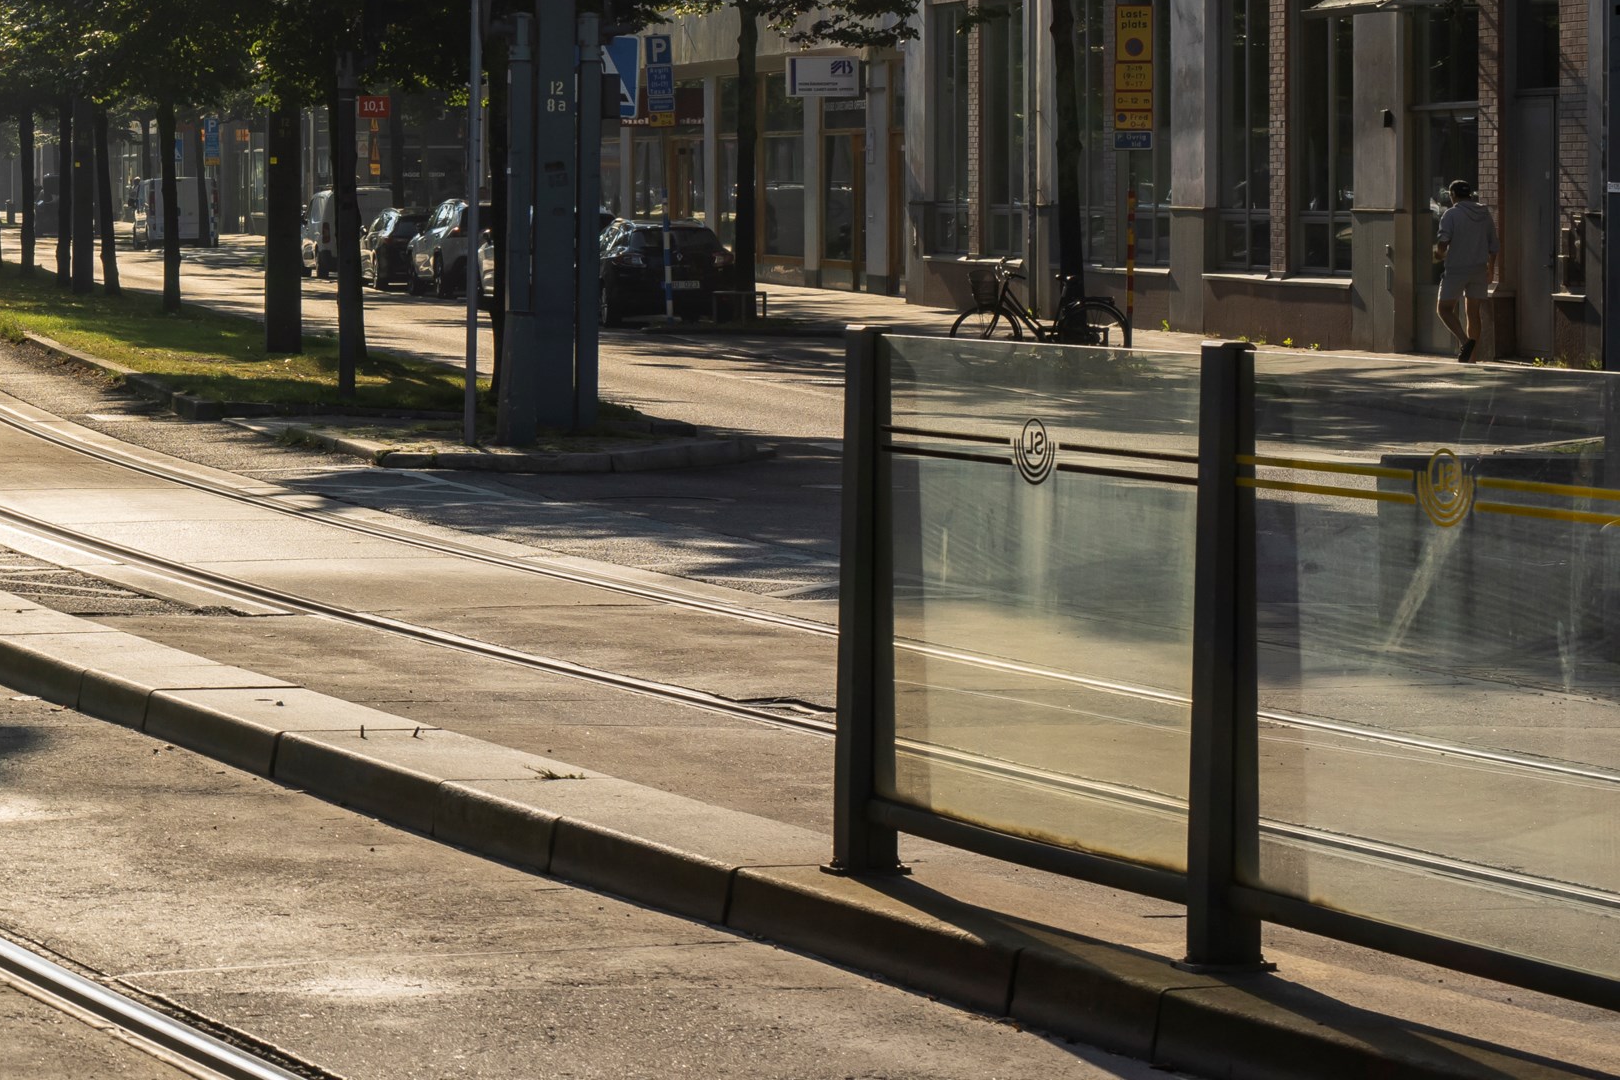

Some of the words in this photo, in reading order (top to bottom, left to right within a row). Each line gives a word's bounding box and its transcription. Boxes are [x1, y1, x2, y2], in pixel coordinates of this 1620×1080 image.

[1121, 19, 1148, 31] plats
[651, 38, 667, 63] P
[550, 80, 565, 95] 12
[363, 101, 385, 112] 10,1
[207, 119, 217, 133] P
